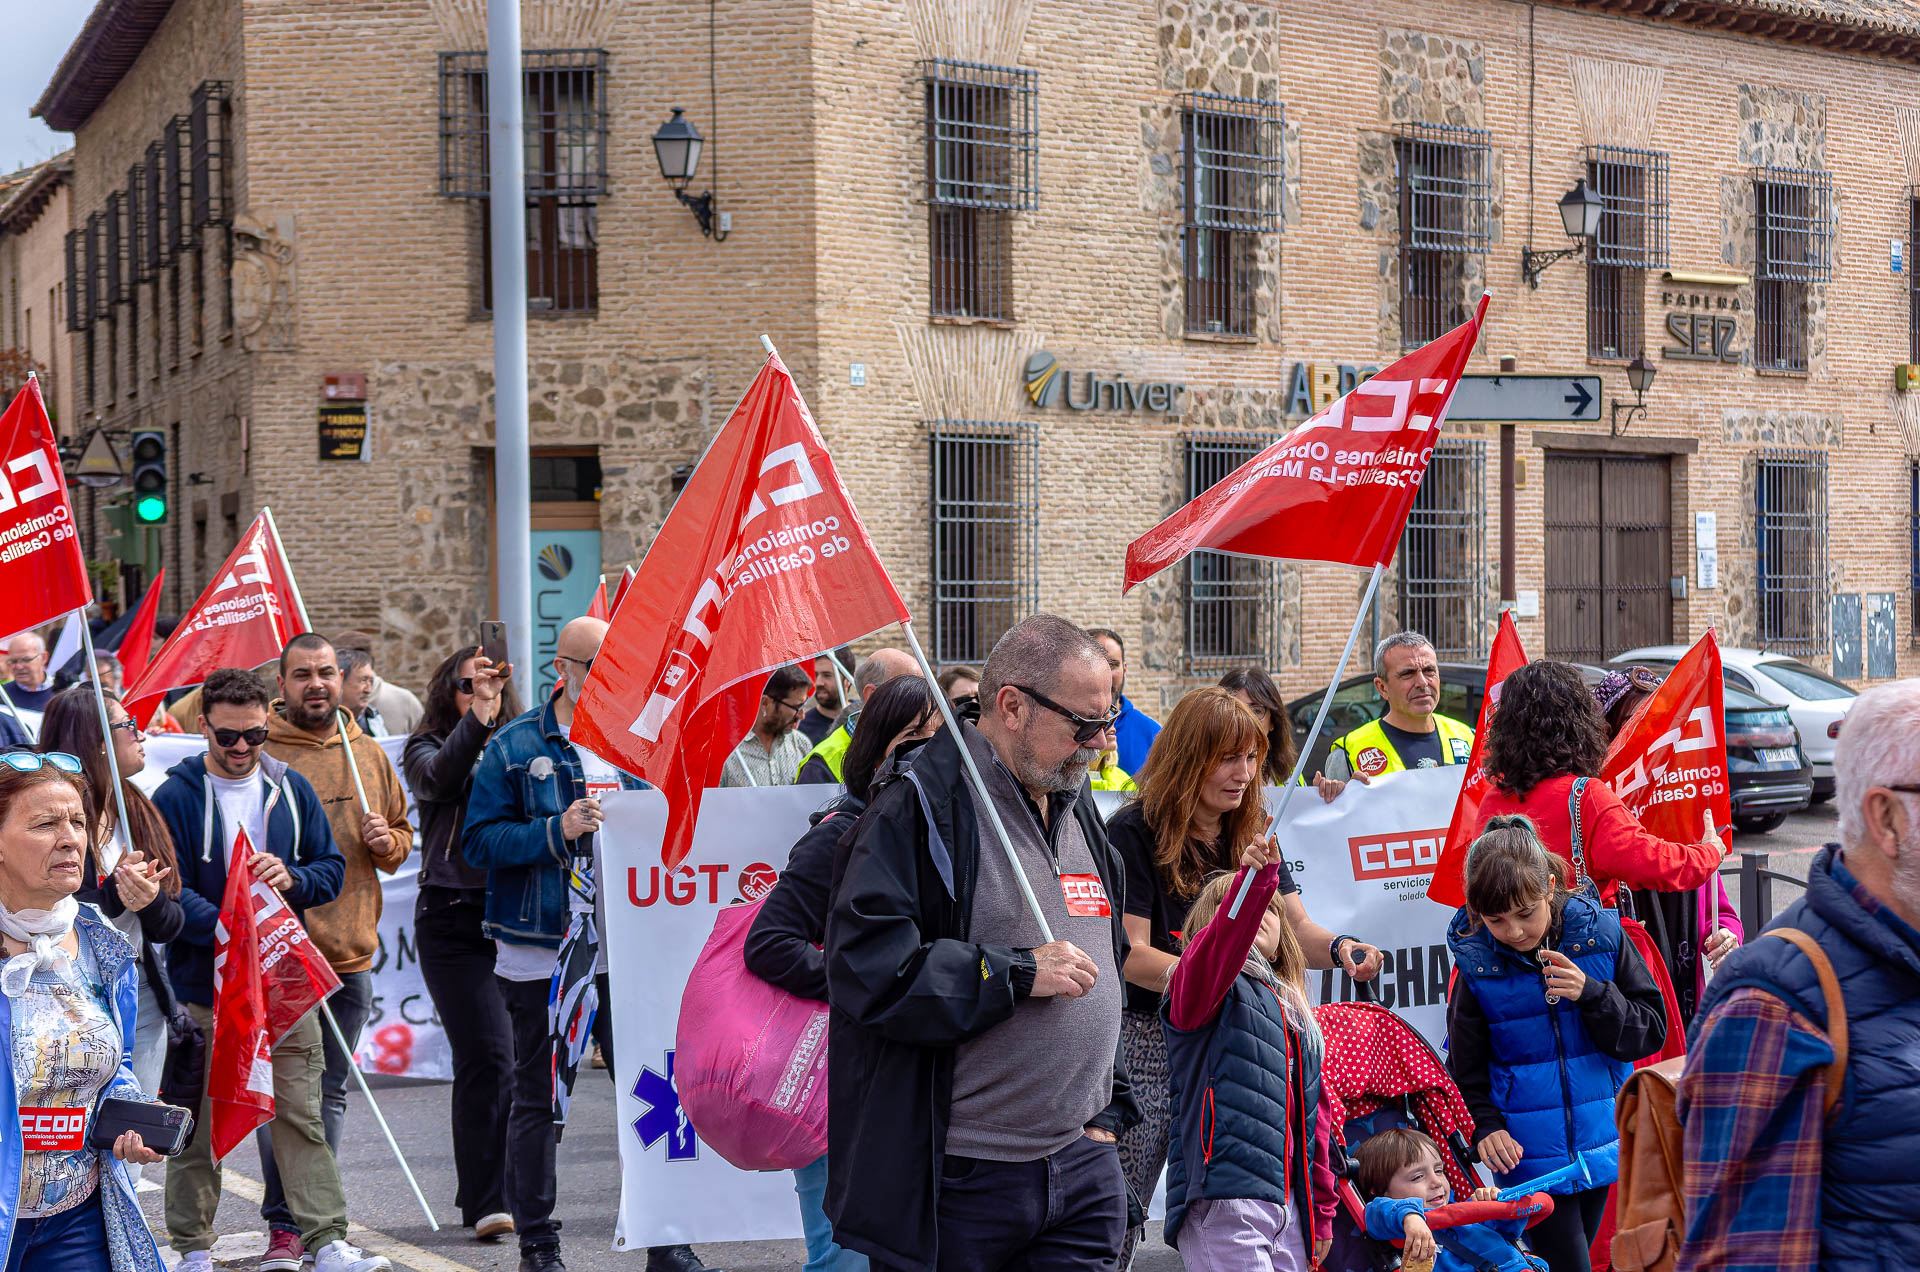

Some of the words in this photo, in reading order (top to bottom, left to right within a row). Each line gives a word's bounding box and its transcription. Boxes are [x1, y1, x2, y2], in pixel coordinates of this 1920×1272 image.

[1661, 312, 1742, 362] SER
[1065, 370, 1185, 411] Univer
[537, 590, 562, 704] Unive
[1359, 748, 1381, 764] UGT
[1359, 837, 1446, 871] CCO
[628, 864, 729, 907] UGT
[1384, 877, 1431, 890] servicios
[1399, 891, 1425, 901] toledo
[775, 1015, 828, 1107] DECATHLON
[20, 1115, 83, 1132] CCOO
